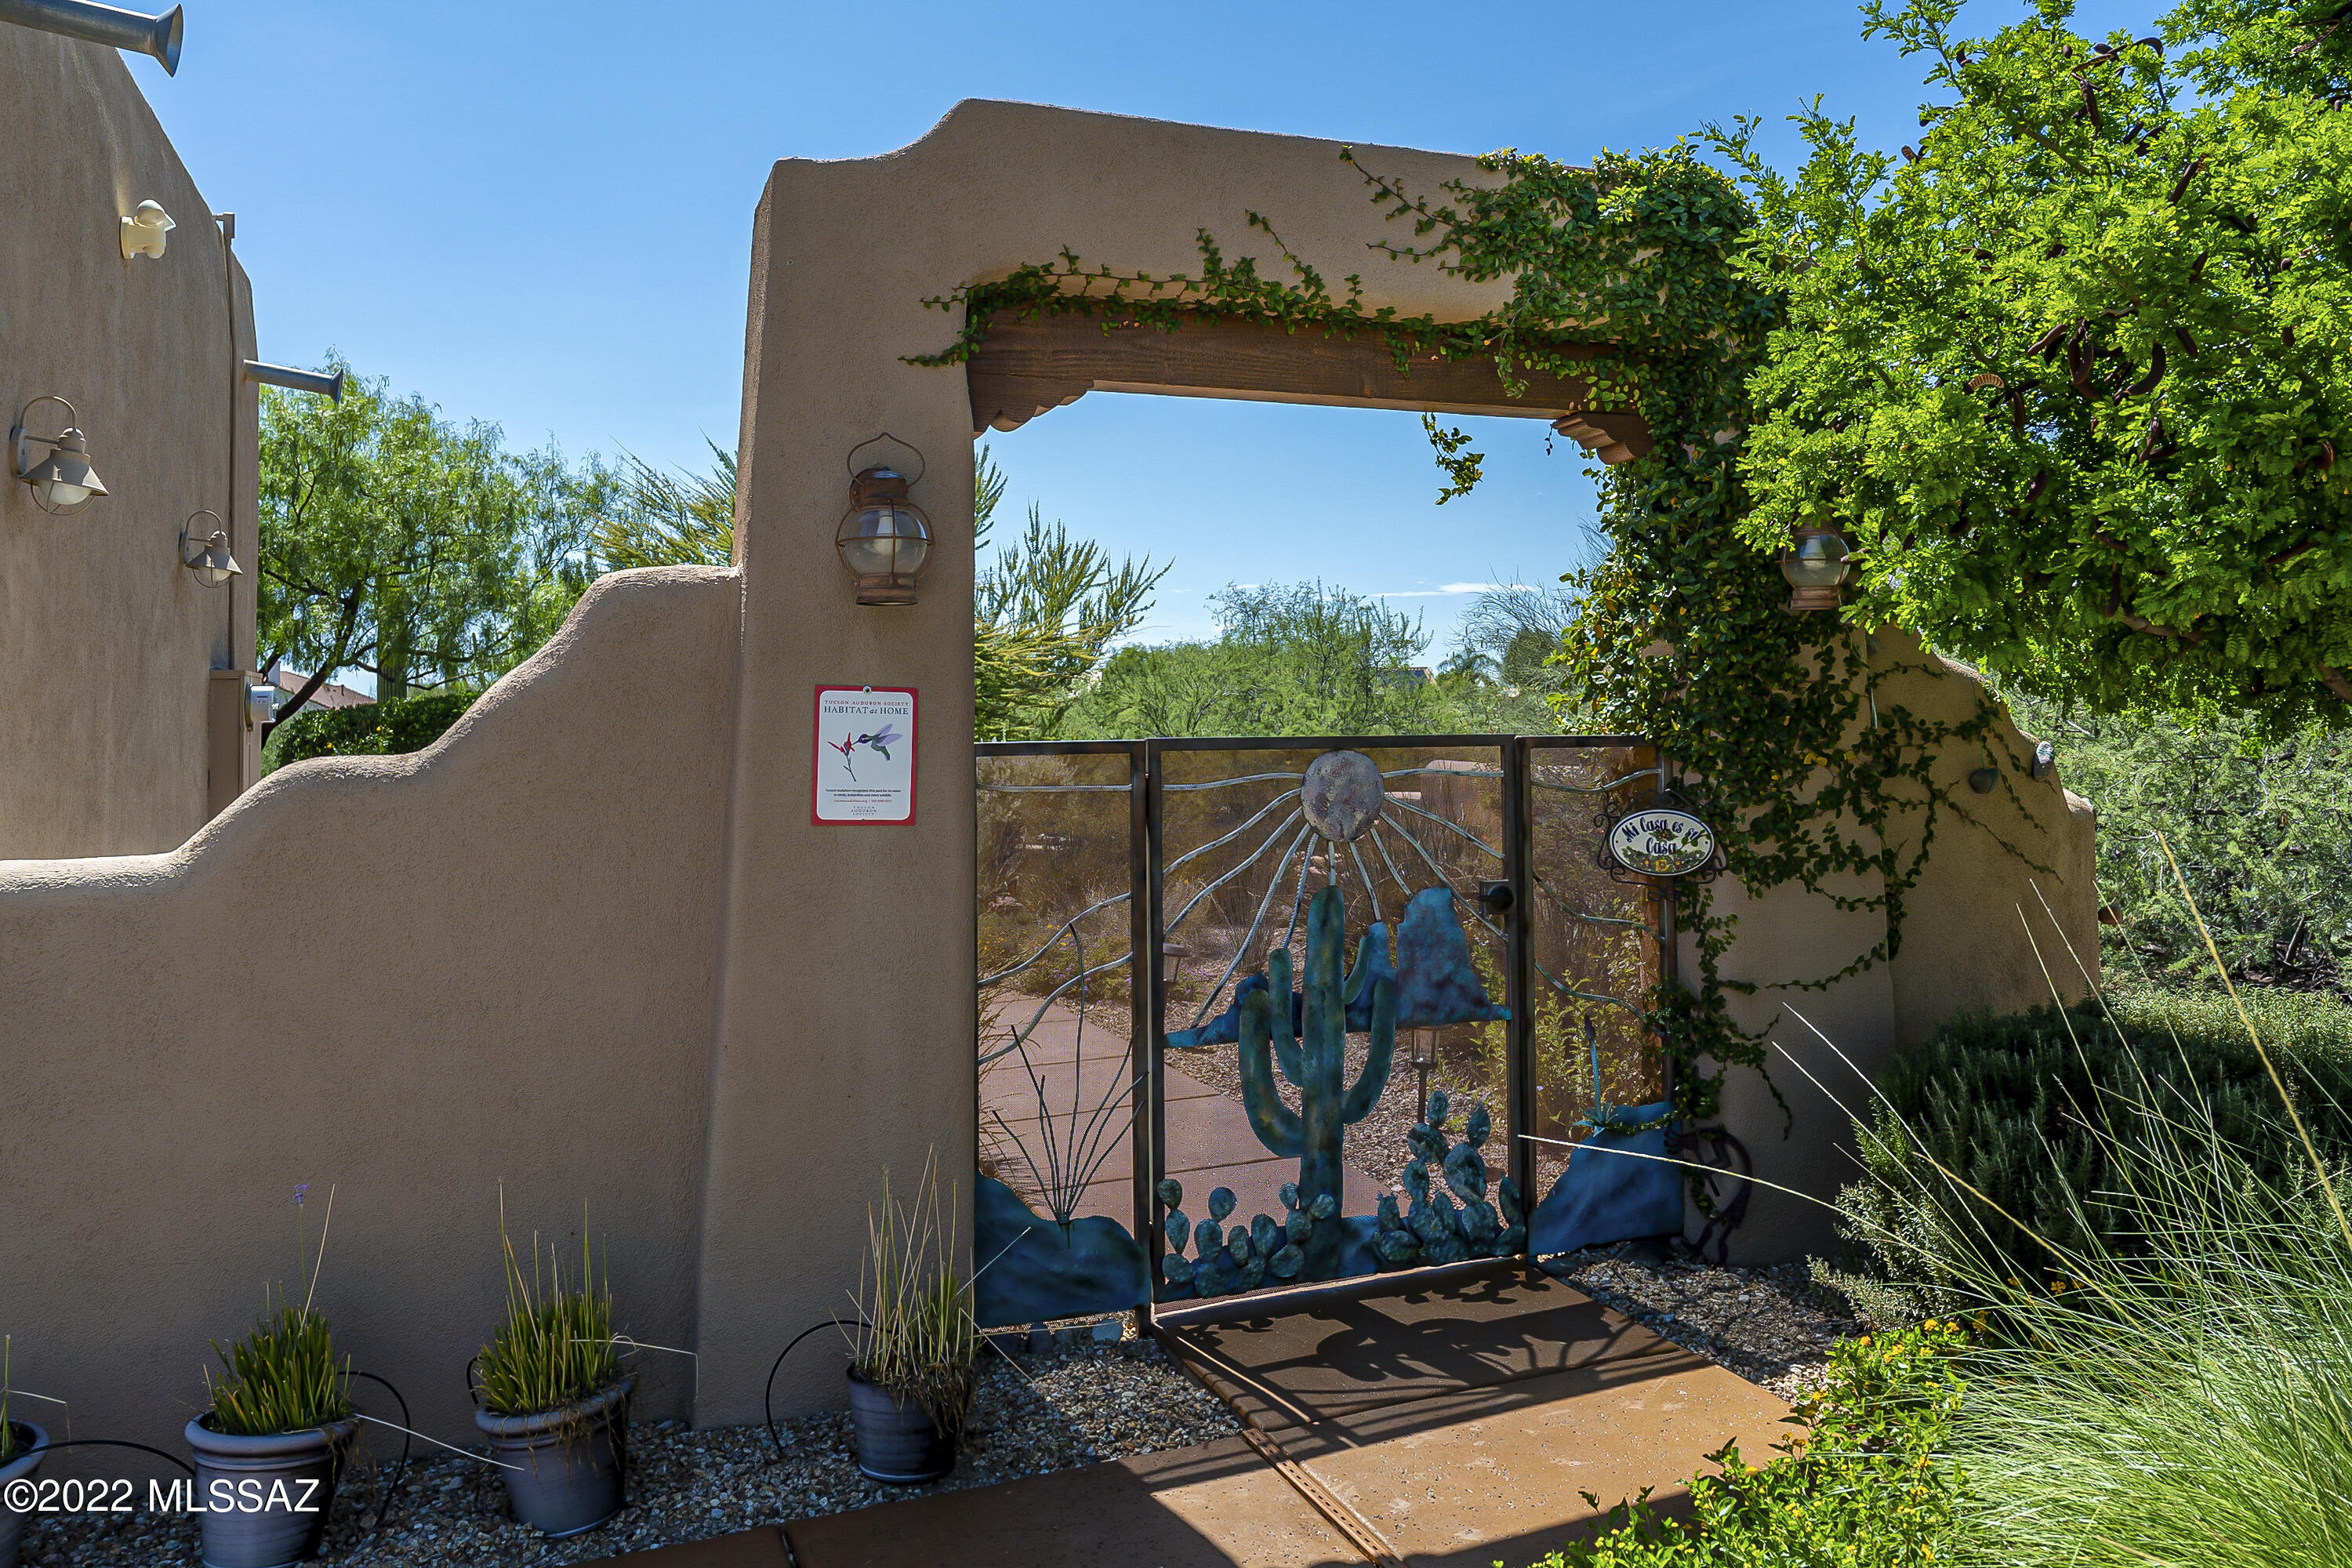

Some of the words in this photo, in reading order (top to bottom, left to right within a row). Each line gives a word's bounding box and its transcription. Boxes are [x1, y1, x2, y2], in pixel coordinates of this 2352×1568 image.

[824, 706, 869, 714] HABITAT
[880, 706, 909, 715] HOME
[1621, 822, 1640, 844] Mi
[1639, 816, 1668, 833] Casa
[1671, 820, 1684, 834] es
[1646, 837, 1677, 855] Casa
